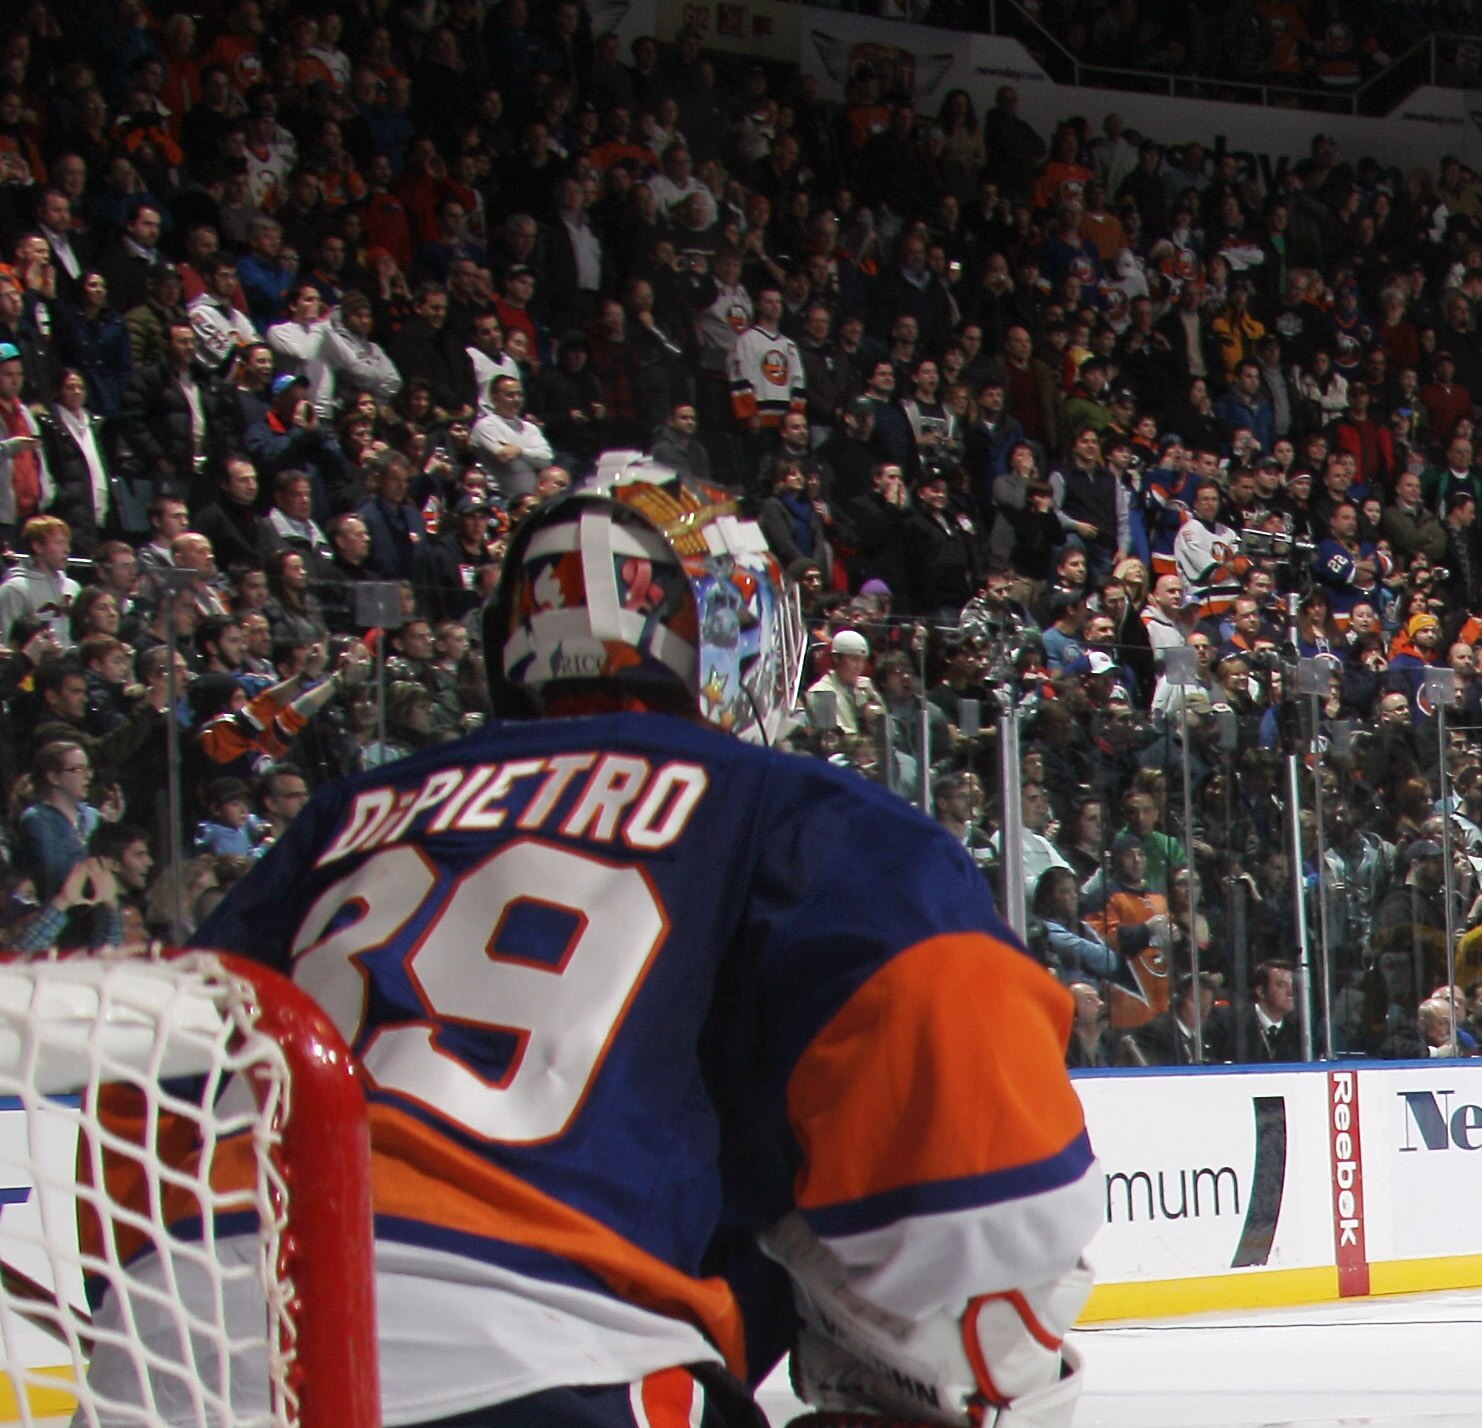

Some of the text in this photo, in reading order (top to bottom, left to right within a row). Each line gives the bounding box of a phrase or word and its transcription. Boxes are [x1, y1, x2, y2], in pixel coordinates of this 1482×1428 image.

[314, 752, 709, 870] DiPIETRO
[291, 835, 672, 1147] 39
[1332, 1071, 1358, 1248] Reebok
